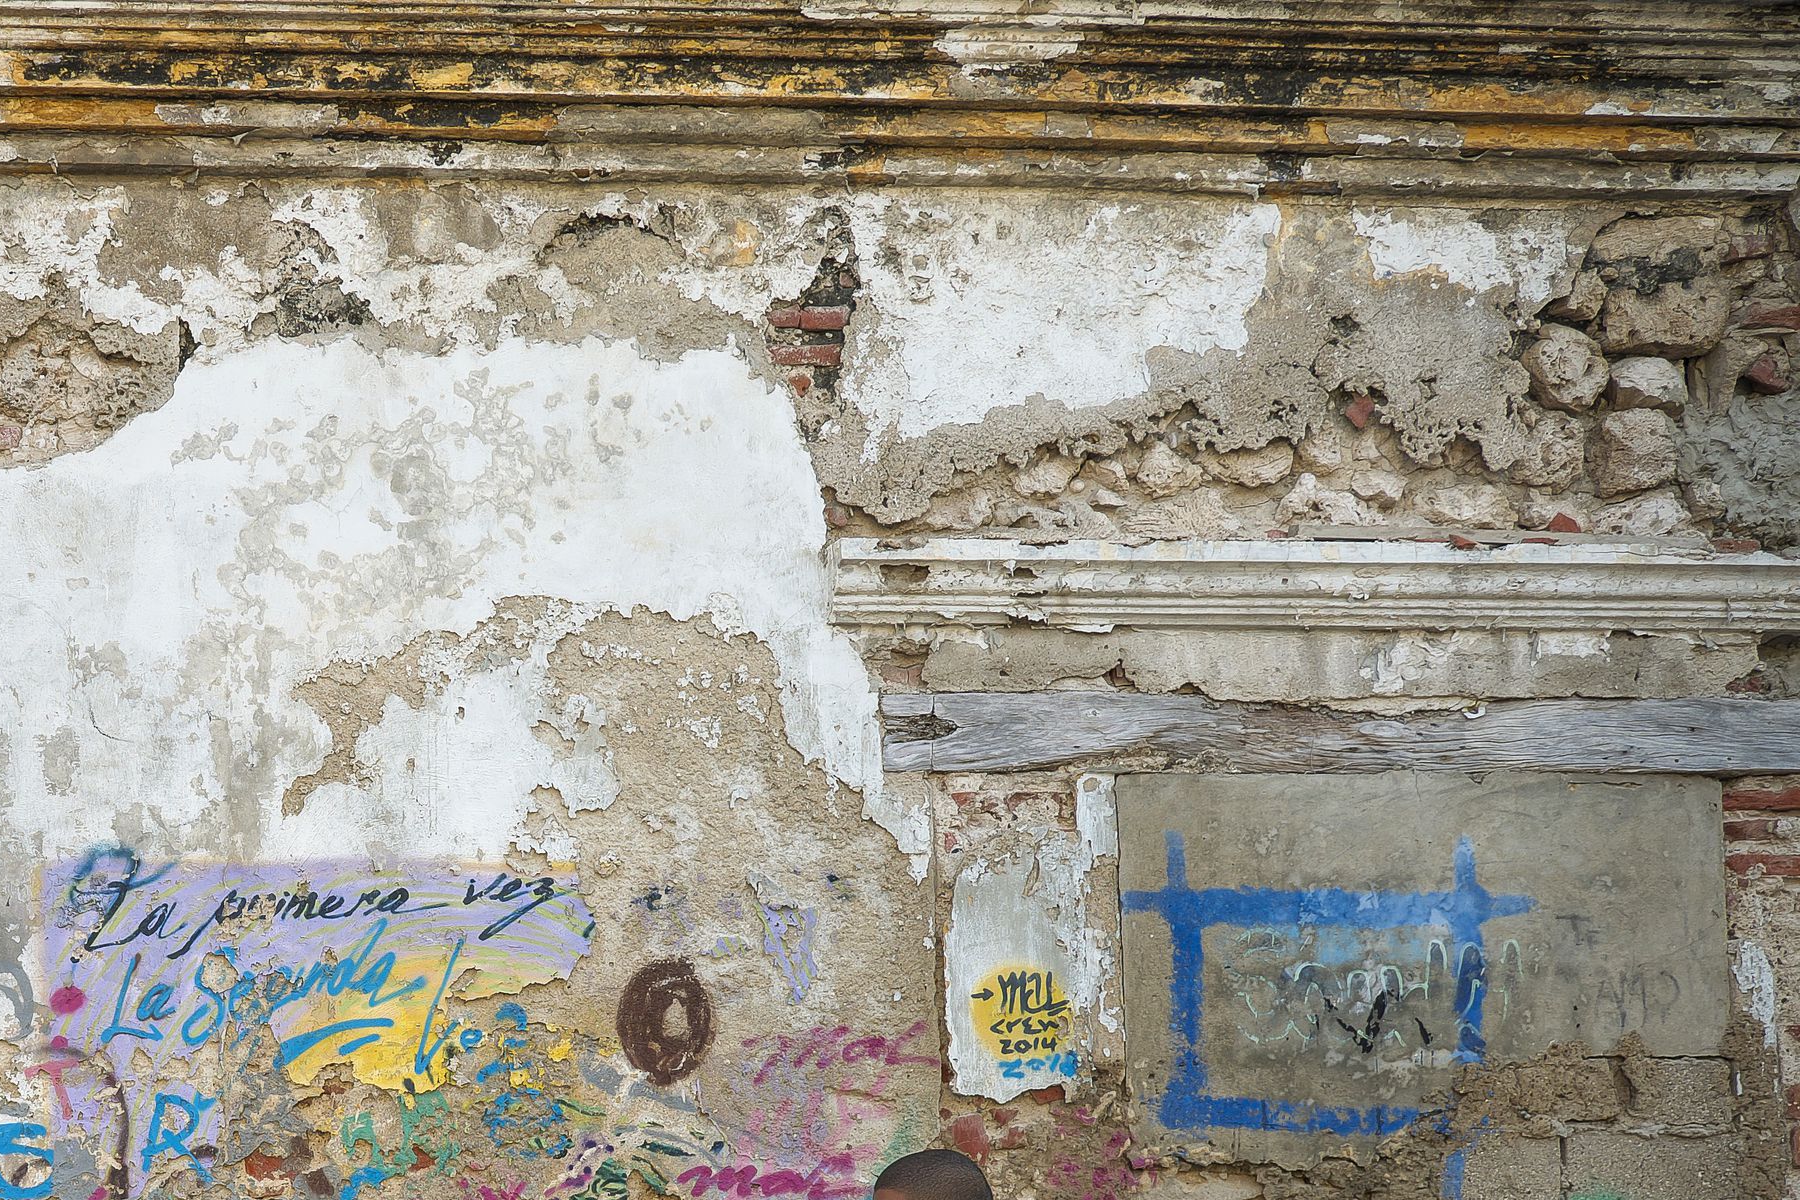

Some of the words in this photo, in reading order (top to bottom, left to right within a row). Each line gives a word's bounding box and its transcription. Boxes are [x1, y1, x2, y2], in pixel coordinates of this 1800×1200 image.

[85, 874, 187, 952] La
[100, 953, 176, 1043] La
[1000, 1037, 1058, 1055] 2014
